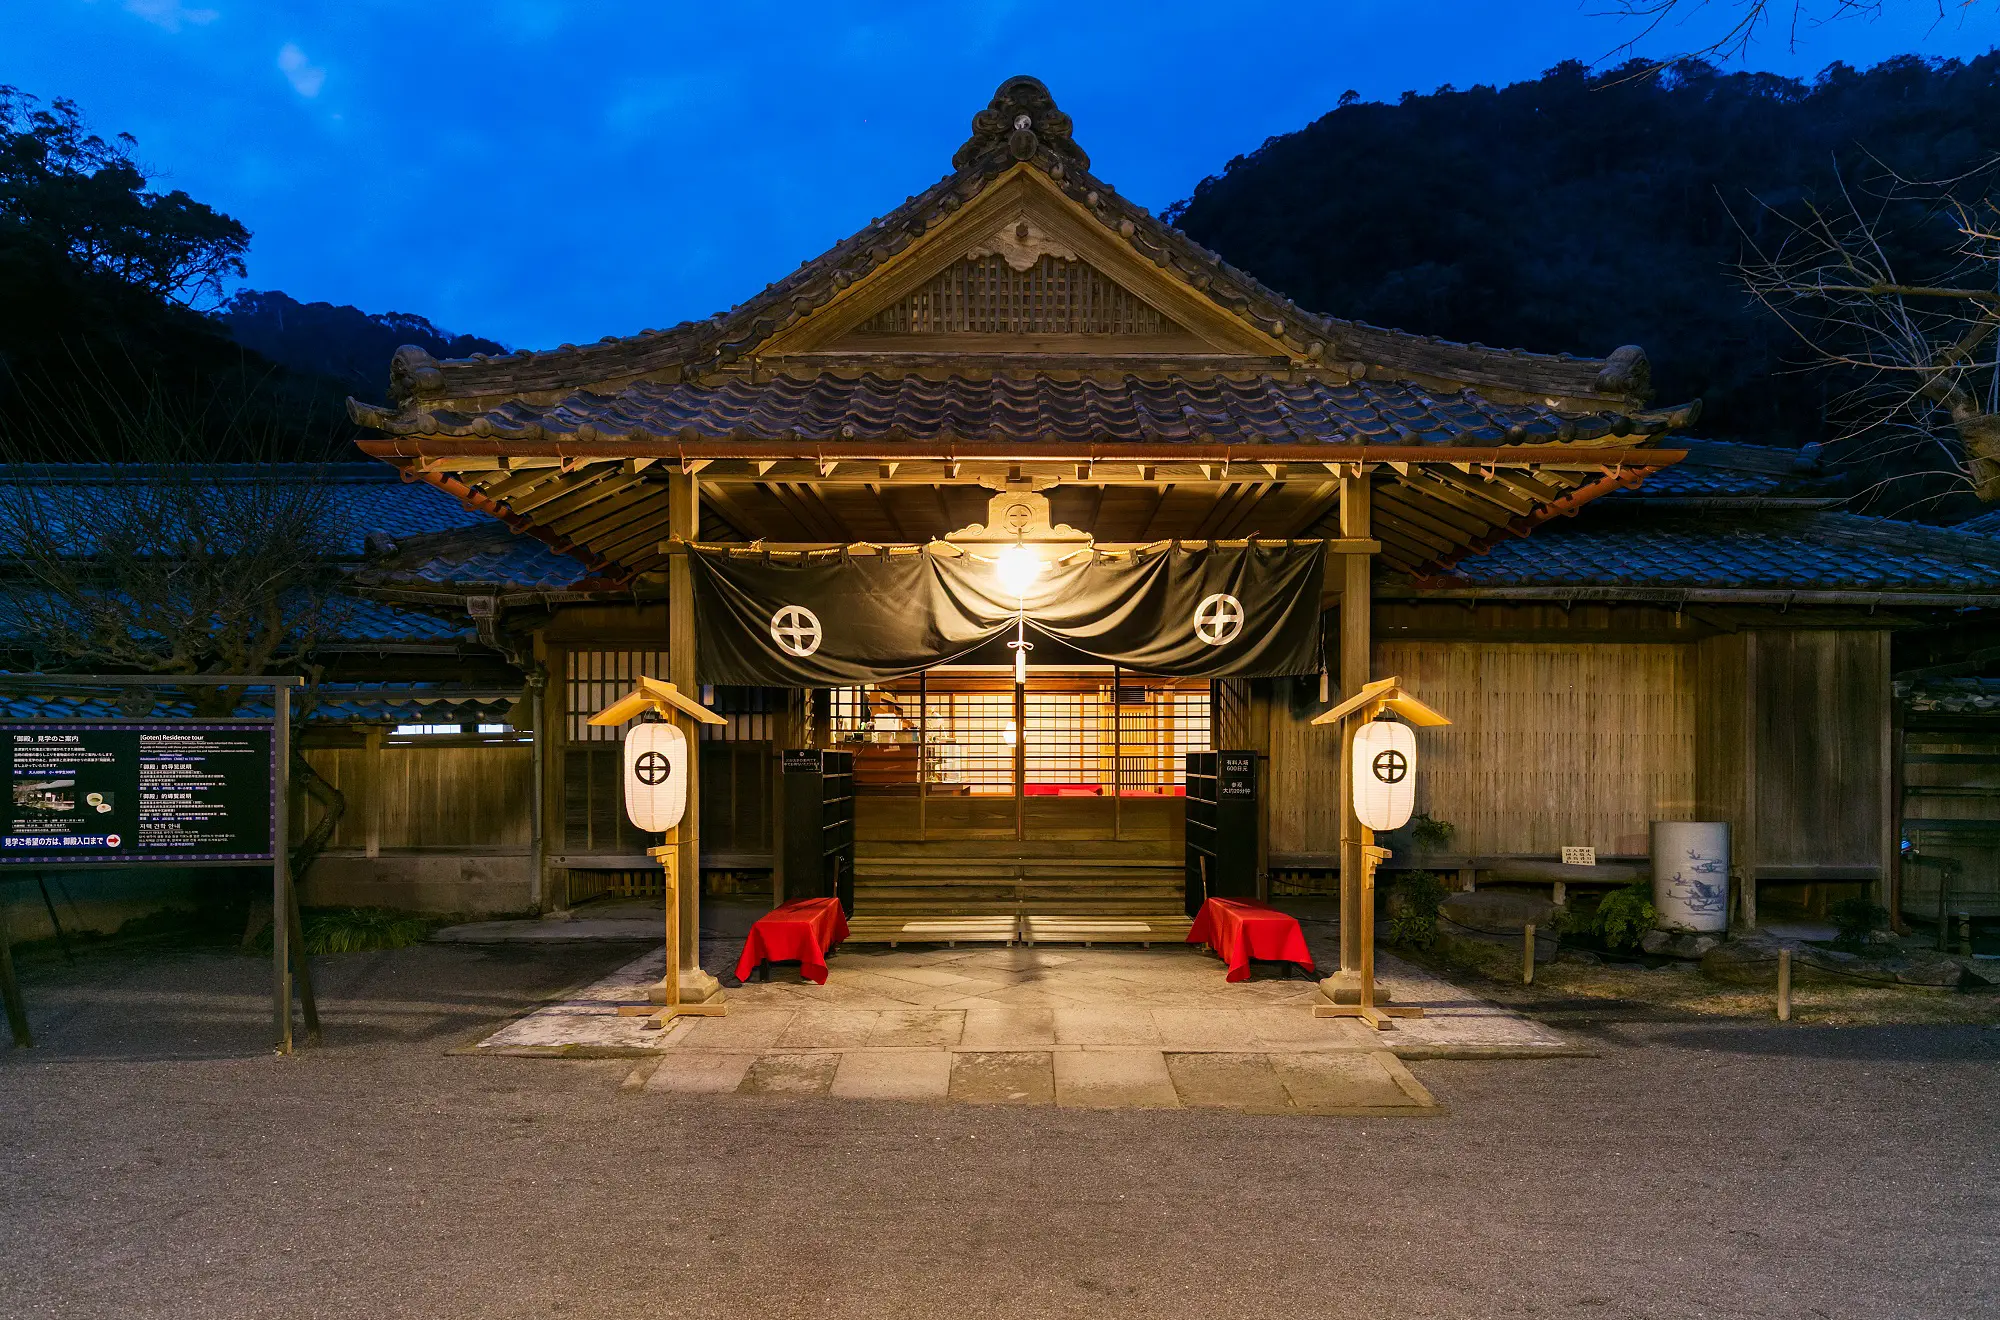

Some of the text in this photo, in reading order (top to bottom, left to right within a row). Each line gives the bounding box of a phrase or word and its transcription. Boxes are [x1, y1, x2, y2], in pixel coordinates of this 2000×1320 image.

[4, 837, 104, 846] 見学ご希望の方は、御殿入口まで
